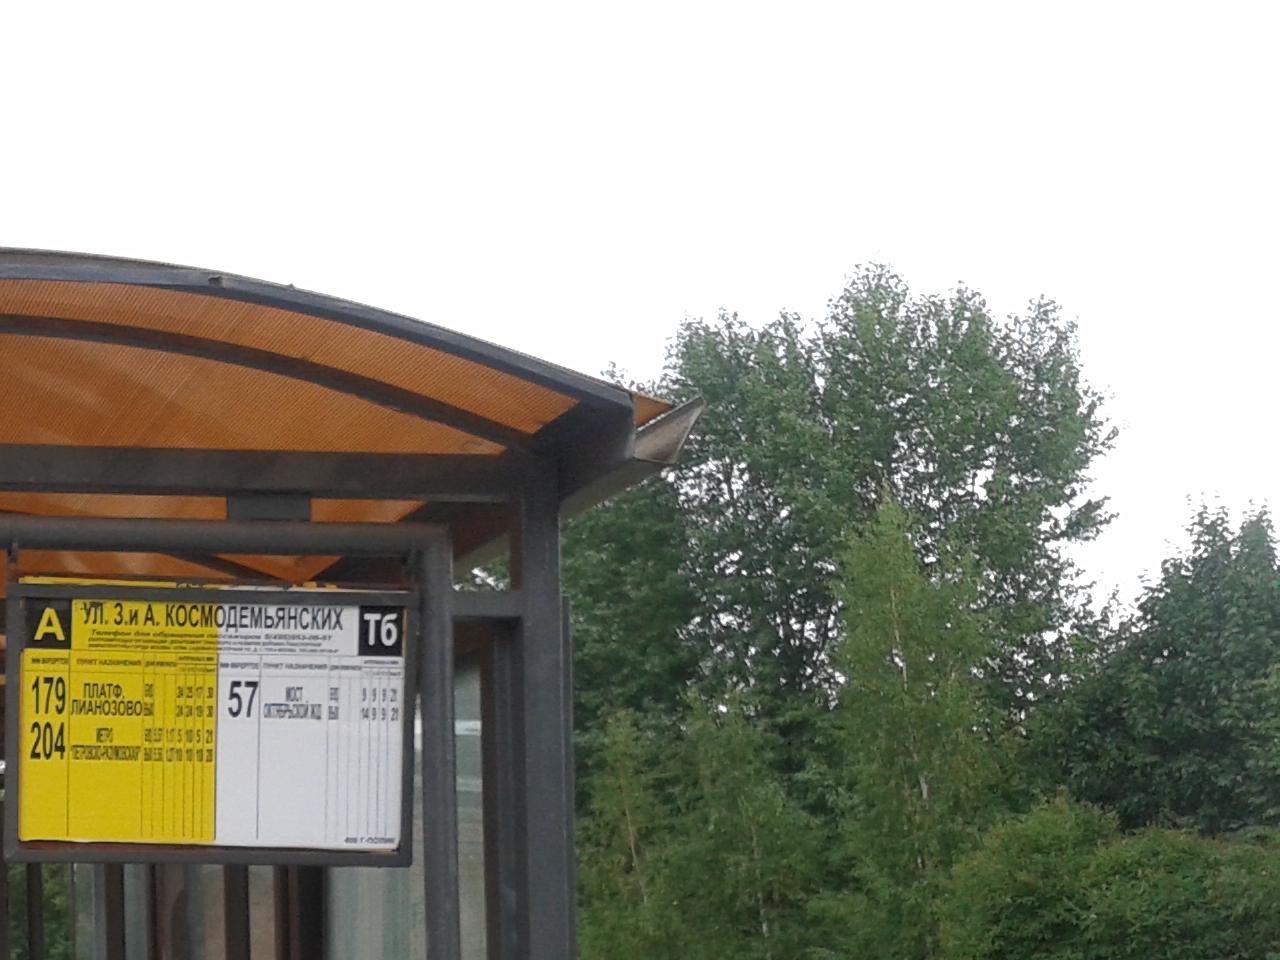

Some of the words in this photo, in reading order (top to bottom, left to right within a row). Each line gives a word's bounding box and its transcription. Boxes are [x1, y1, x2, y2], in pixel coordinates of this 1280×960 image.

[34, 607, 65, 641] А
[83, 602, 109, 625] УЛ.
[143, 604, 160, 627] А.
[165, 603, 344, 633] КОСМОДЕМЬЯНСКИХ
[32, 676, 66, 715] 179
[70, 699, 142, 717] ЛИАНОЗОВО
[83, 683, 125, 701] ПЛАТФ.
[227, 681, 260, 718] 57
[29, 721, 66, 761] 204
